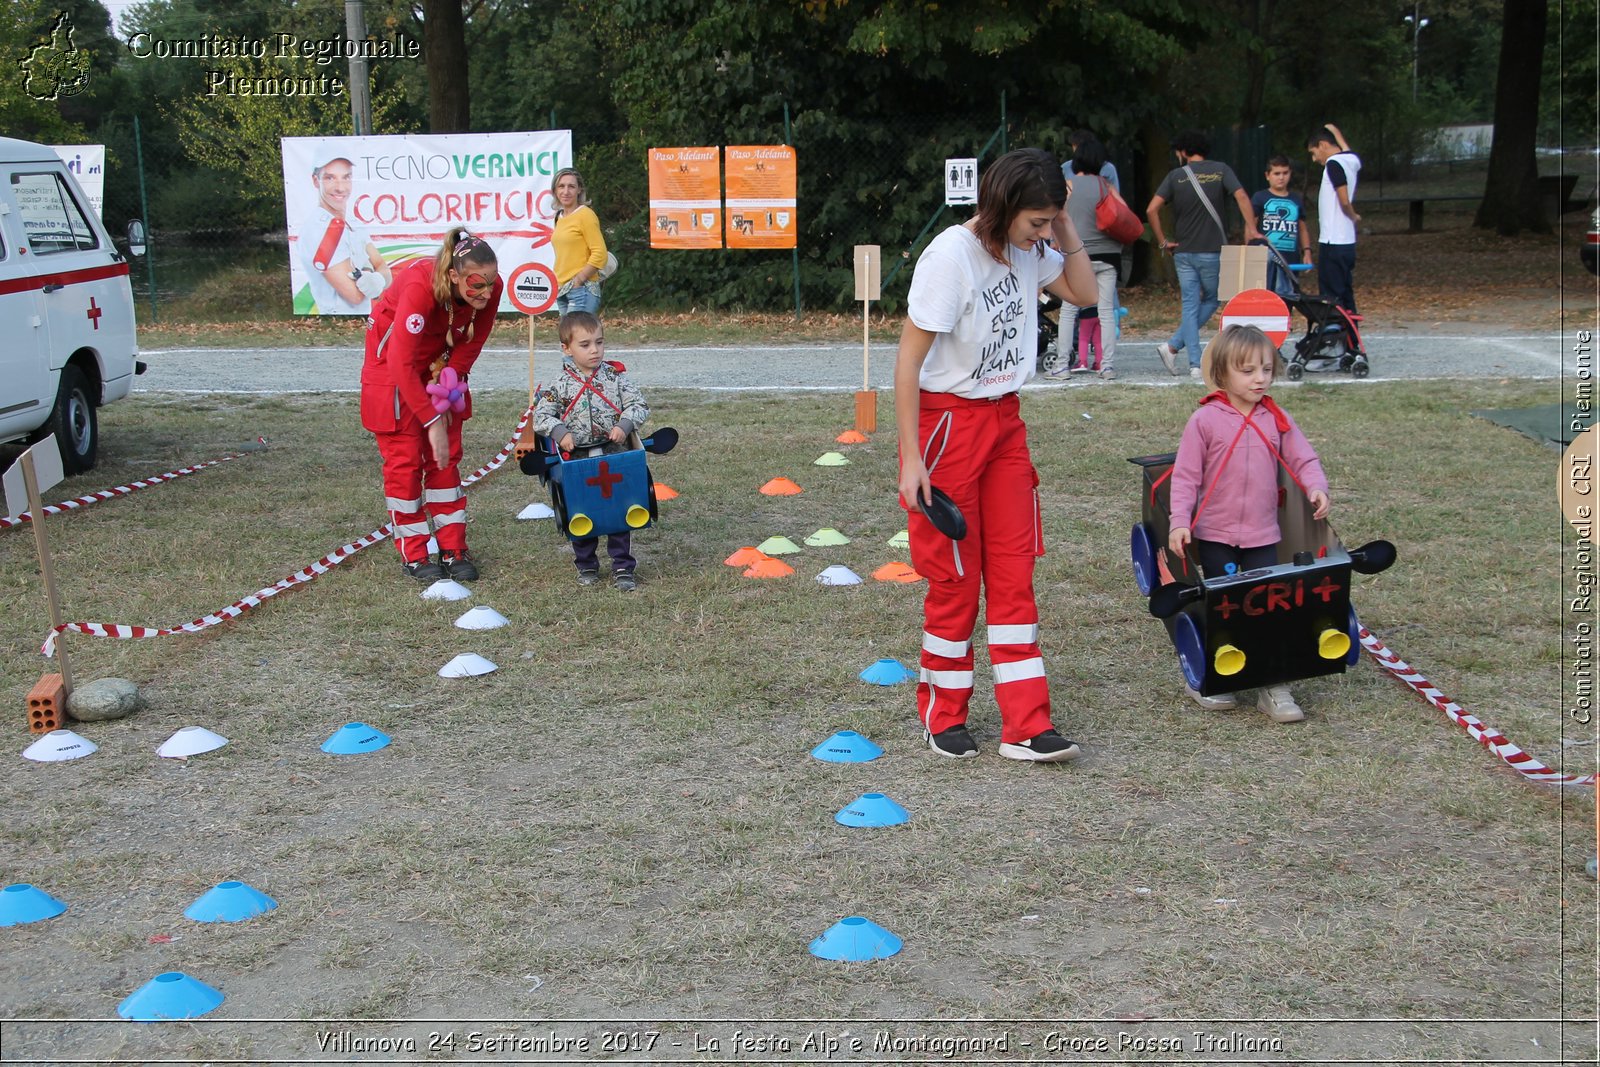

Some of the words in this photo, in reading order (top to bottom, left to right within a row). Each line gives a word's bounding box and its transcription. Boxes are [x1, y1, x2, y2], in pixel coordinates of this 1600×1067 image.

[654, 151, 674, 161] Paso
[675, 150, 715, 162] Adelante
[731, 149, 751, 160] Paso
[751, 149, 791, 160] Adelante
[353, 190, 553, 224] COLORIFICIO
[1263, 219, 1297, 233] STATE
[523, 276, 542, 285] ALT
[1243, 579, 1304, 616] CRI
